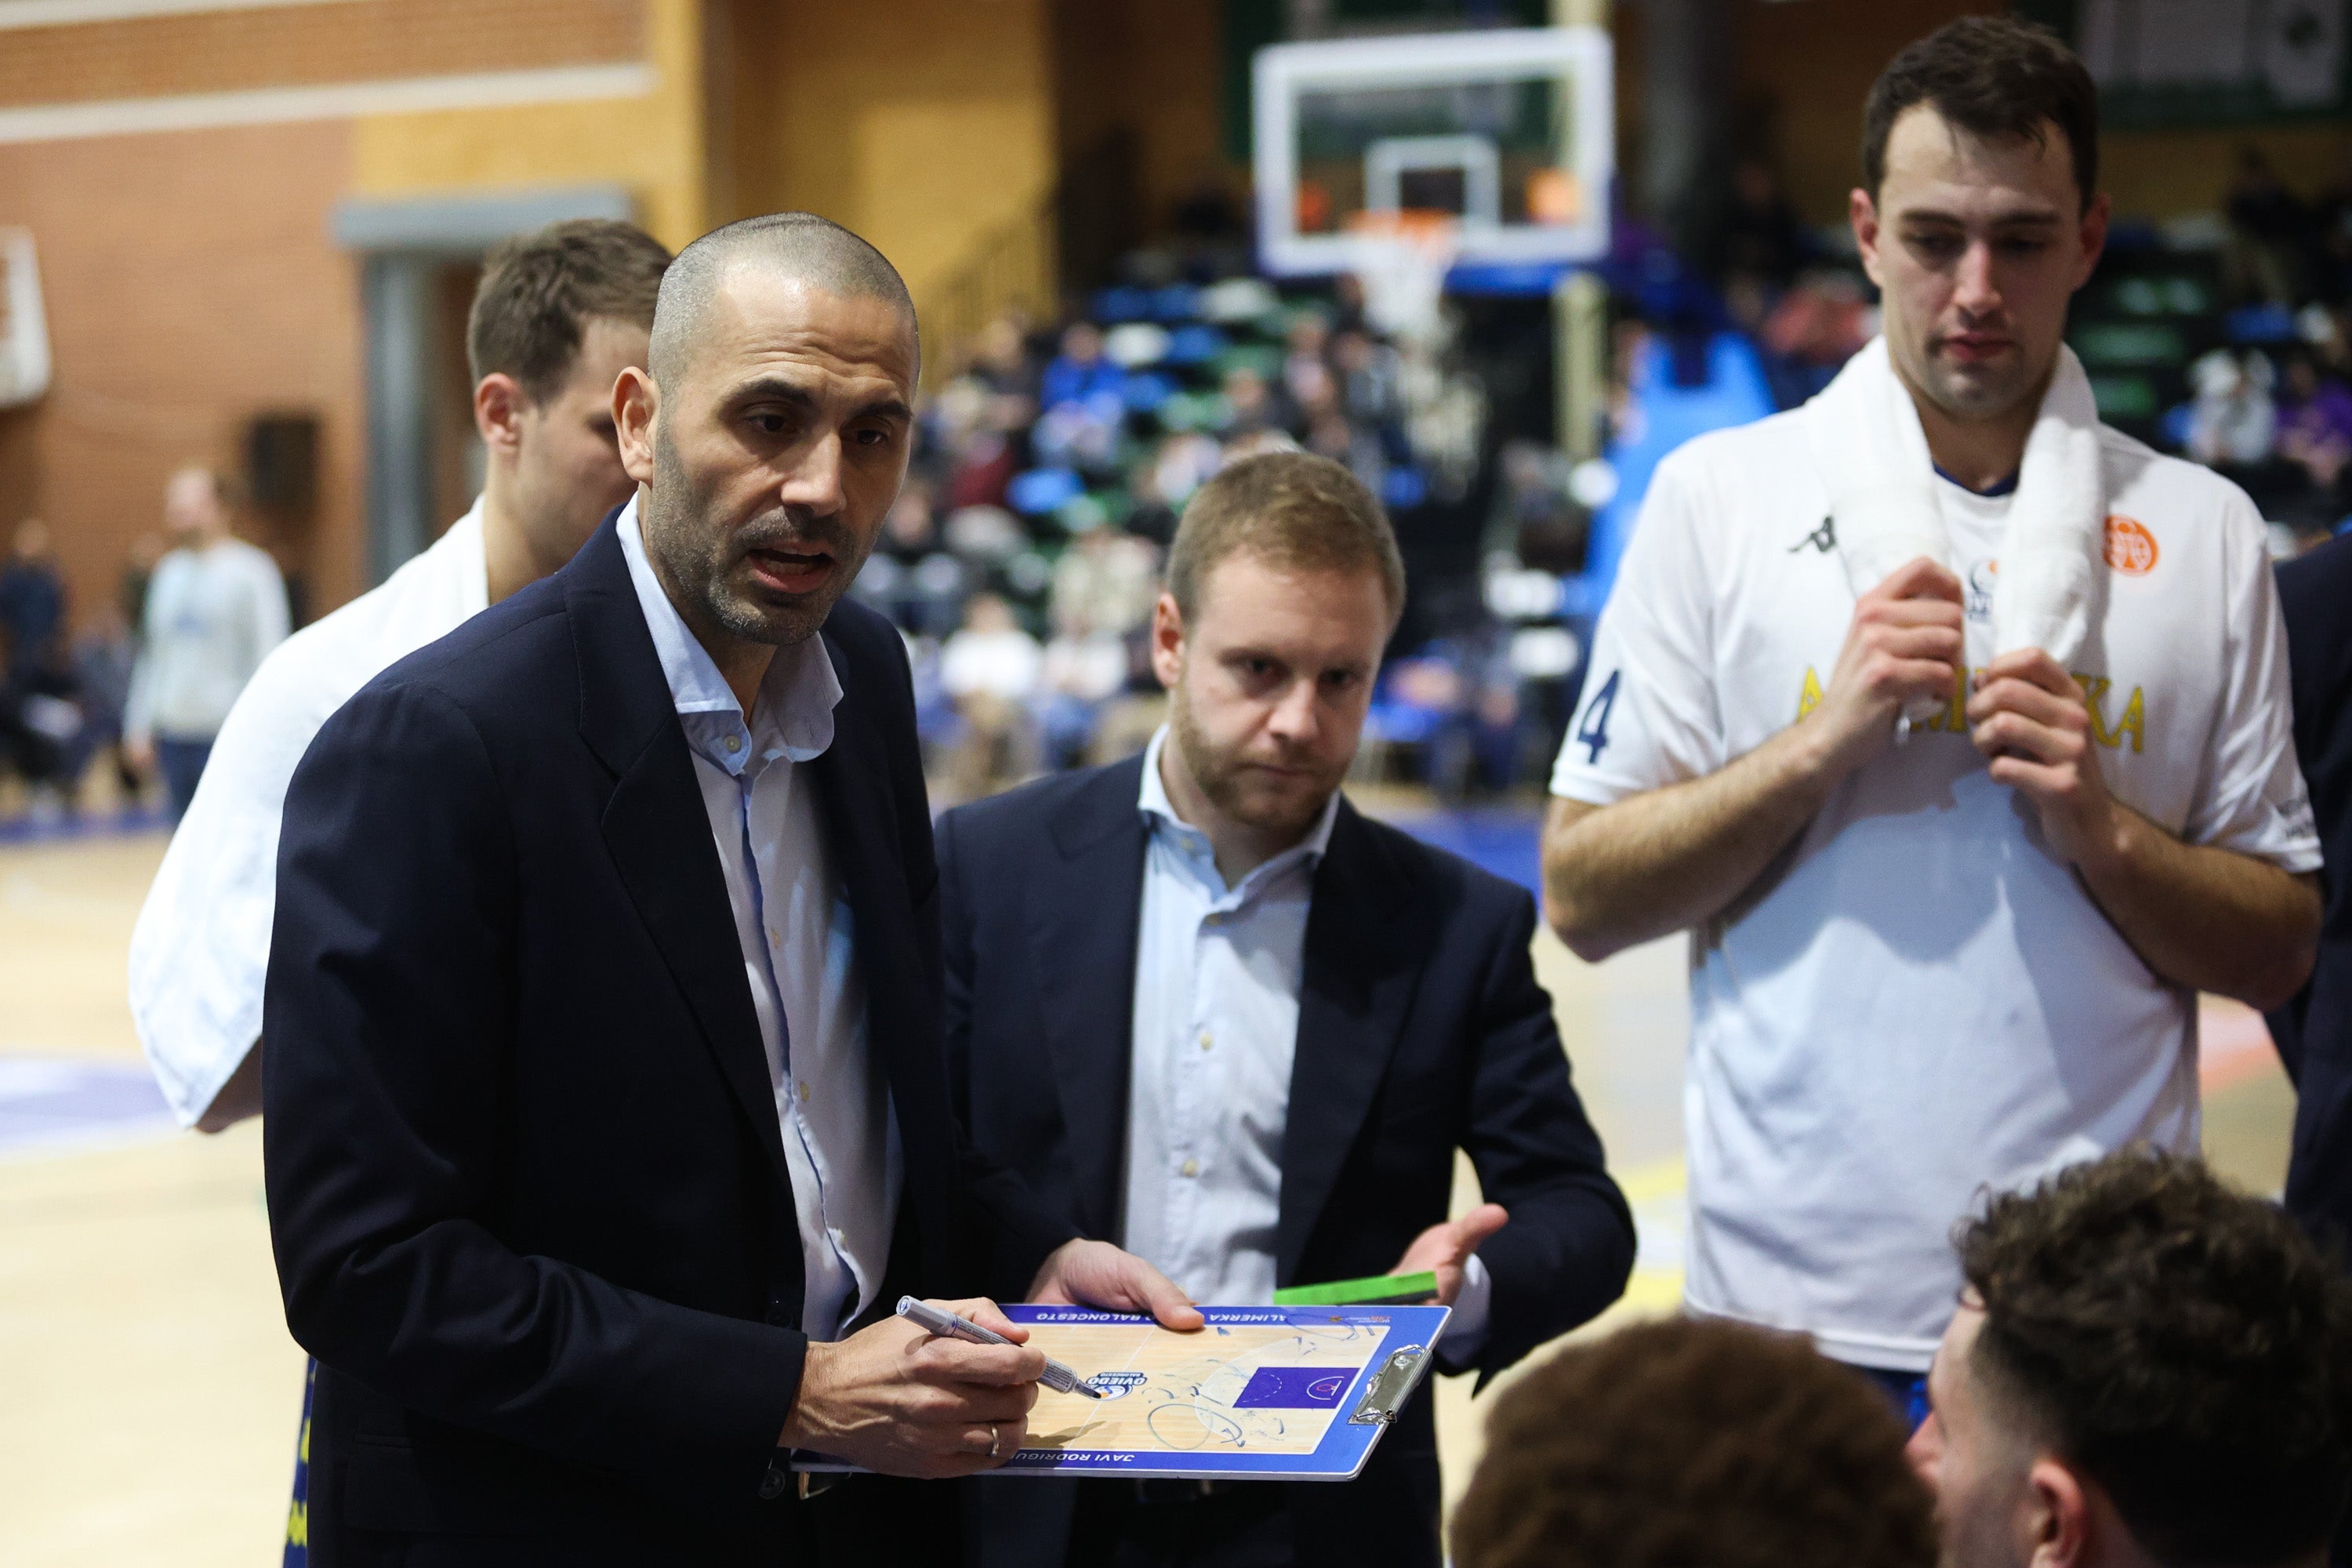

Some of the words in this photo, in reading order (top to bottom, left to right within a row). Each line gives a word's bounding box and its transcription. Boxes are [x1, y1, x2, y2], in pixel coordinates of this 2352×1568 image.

[1577, 669, 1620, 764] 4
[1036, 1312, 1142, 1321] BALONCESTO
[1209, 1313, 1287, 1322] ALIMERKA
[1087, 1377, 1146, 1385] OVIEDO
[1010, 1453, 1091, 1461] RODRIGU
[1094, 1454, 1135, 1462] JAVI
